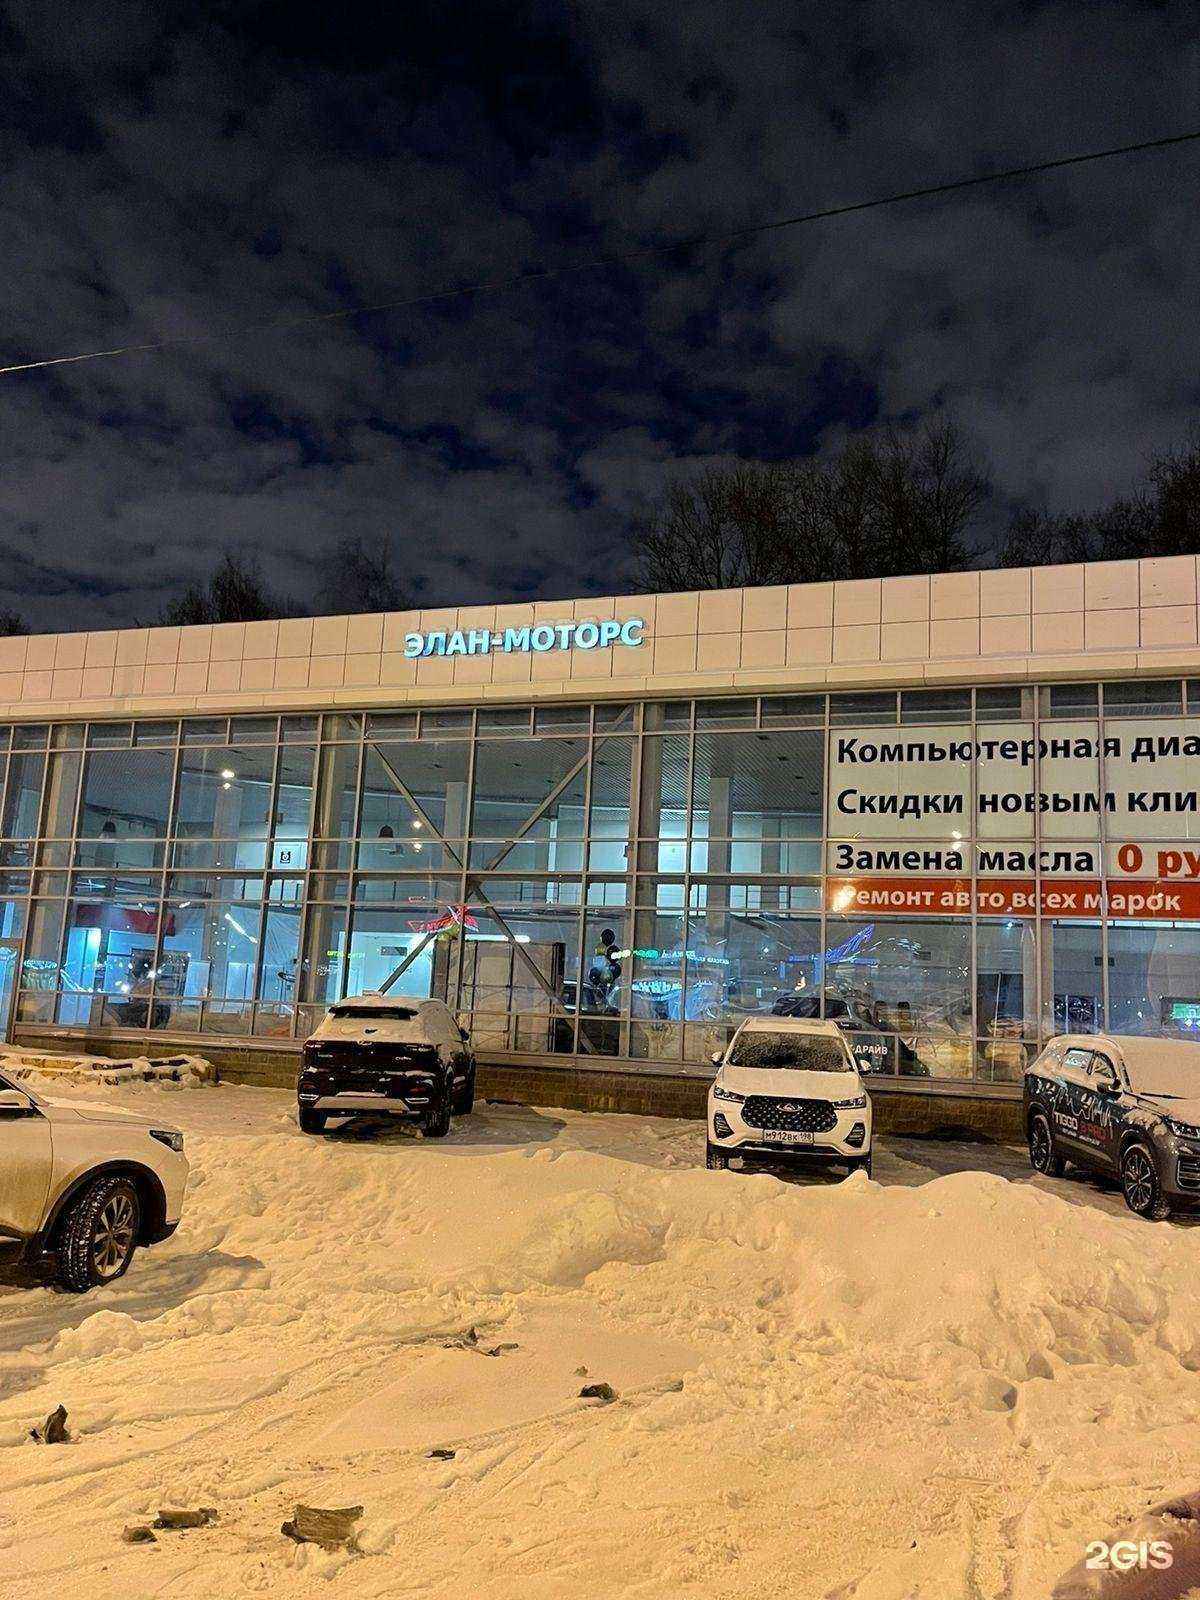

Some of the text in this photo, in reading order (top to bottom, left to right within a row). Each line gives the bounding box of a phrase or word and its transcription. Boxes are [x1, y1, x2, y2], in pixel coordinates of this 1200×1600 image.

[404, 619, 644, 659] ЭЛАН-МОТОРС
[837, 736, 1200, 766] Компьютерная диа
[837, 788, 1197, 819] Скидки новым кли
[835, 844, 964, 872] Замена
[979, 851, 1094, 872] масла
[940, 890, 1005, 908] авто
[1011, 892, 1077, 909] всех
[1083, 892, 1182, 916] марок
